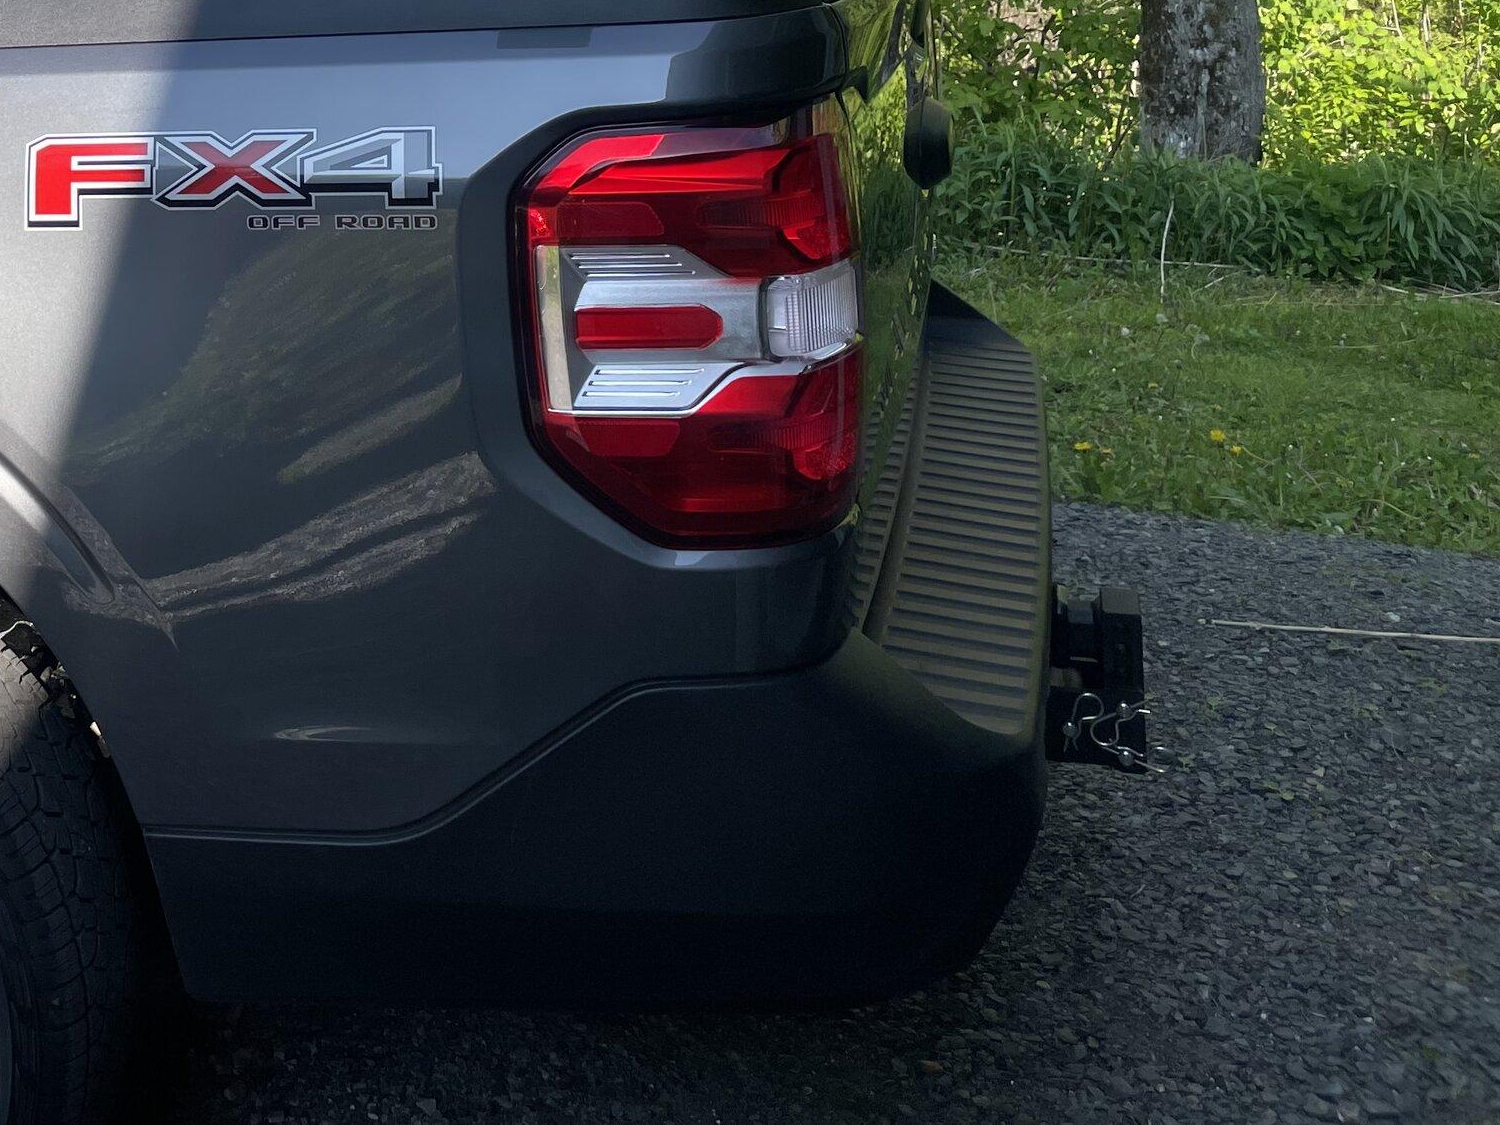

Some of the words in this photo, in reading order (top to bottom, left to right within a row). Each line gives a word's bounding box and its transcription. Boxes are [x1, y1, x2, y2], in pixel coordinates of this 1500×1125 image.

[26, 126, 443, 231] FX4
[247, 214, 321, 231] OFF
[334, 214, 439, 231] ROAD
